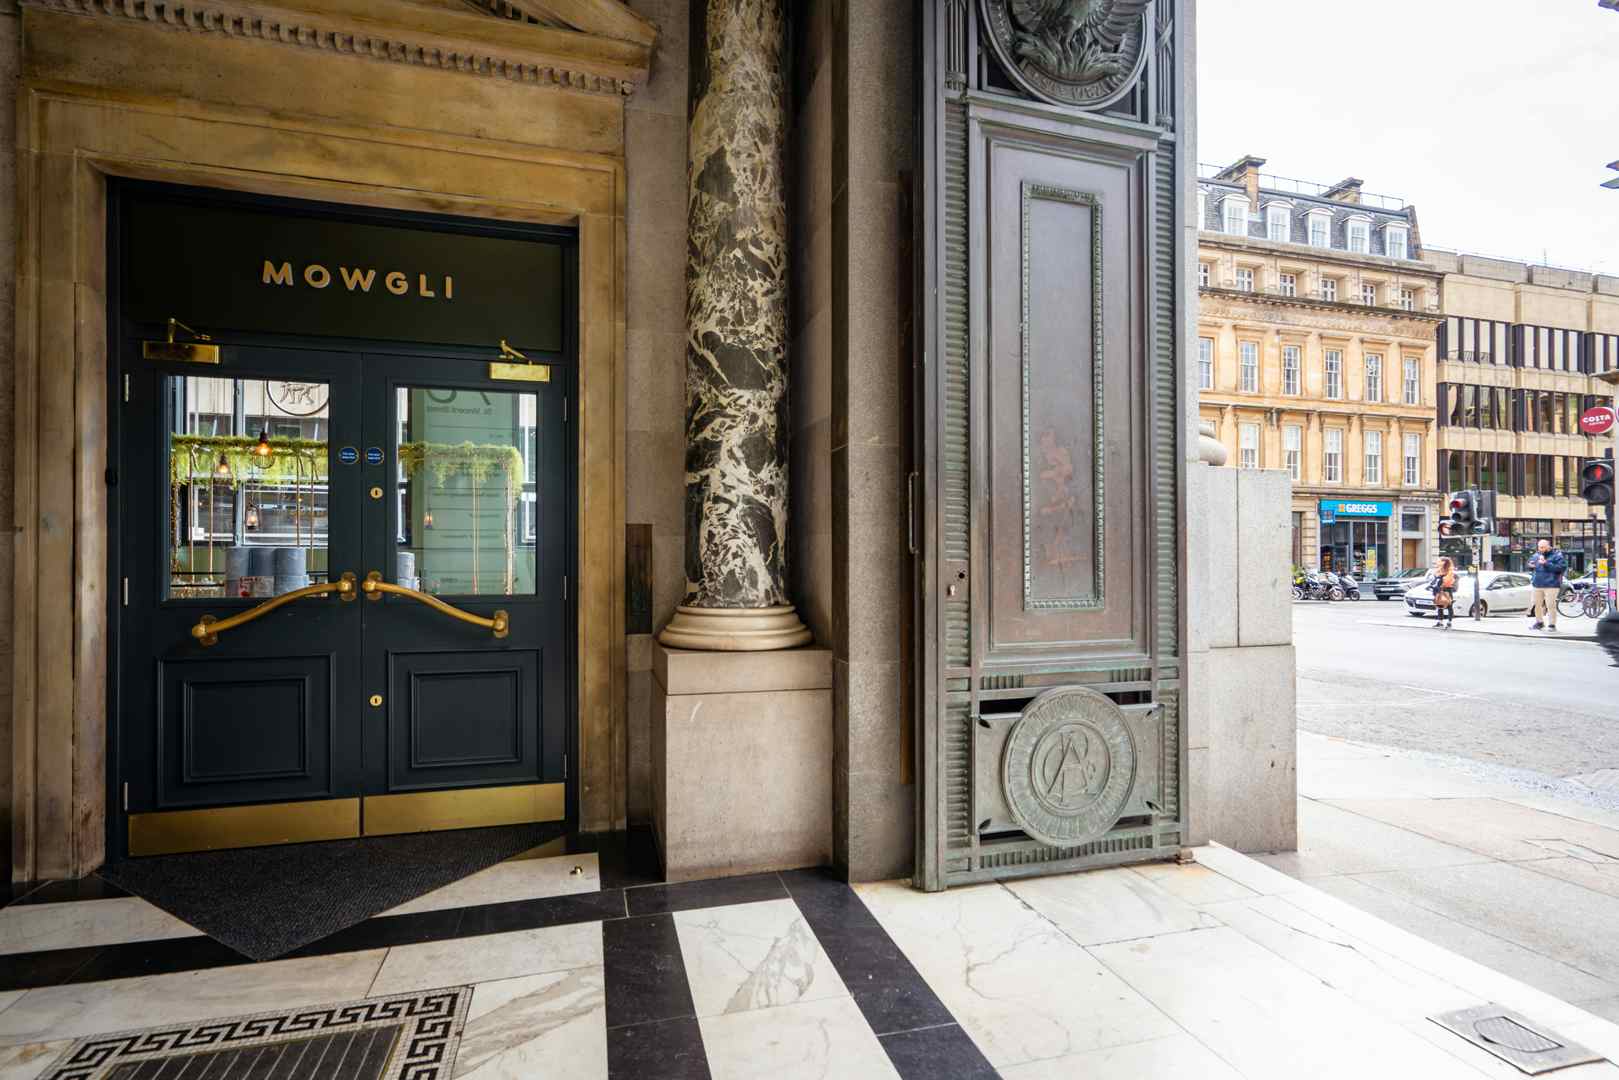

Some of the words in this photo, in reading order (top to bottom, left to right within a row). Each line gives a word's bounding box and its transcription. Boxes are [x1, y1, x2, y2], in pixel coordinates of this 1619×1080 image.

[262, 260, 453, 299] MOWGLI
[1583, 414, 1611, 423] COSTA
[1346, 503, 1378, 513] GREGGS
